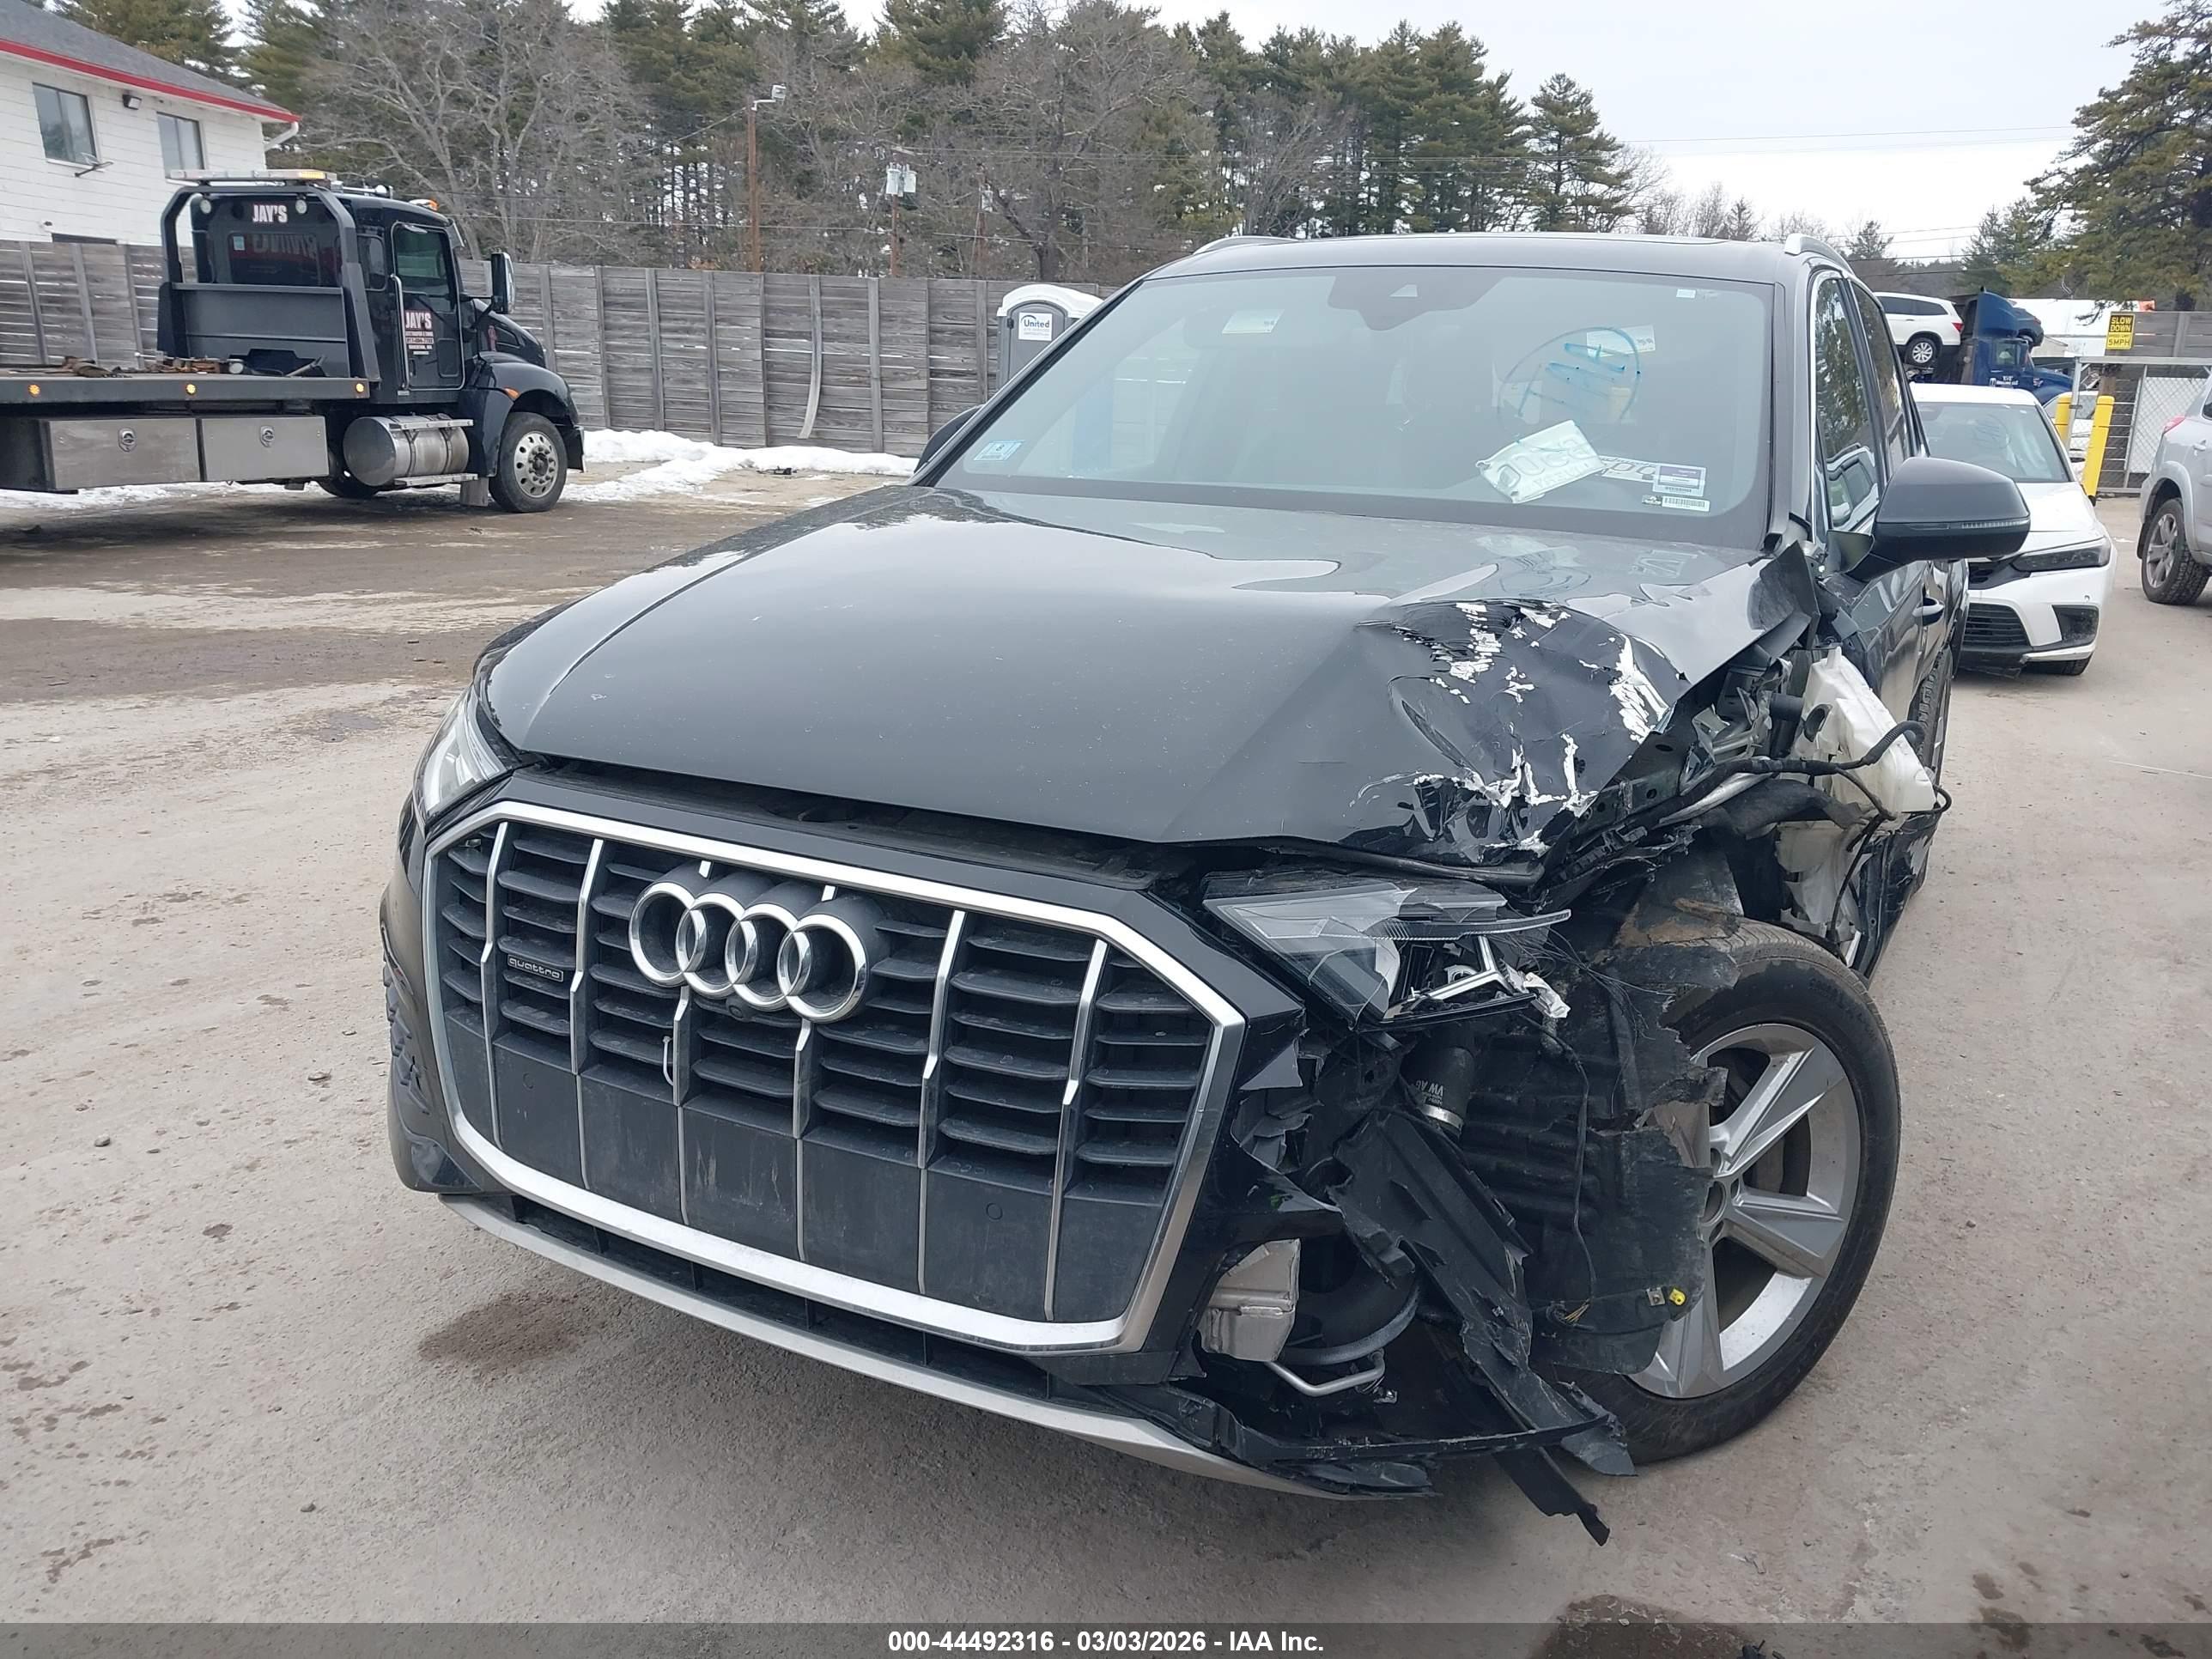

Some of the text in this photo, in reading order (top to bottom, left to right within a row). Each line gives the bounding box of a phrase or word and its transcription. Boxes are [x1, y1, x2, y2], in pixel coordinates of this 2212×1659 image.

[252, 204, 288, 222] JAY'S
[405, 312, 432, 330] JAY'S
[1024, 319, 1049, 328] United
[2111, 316, 2132, 325] SLOW
[509, 957, 560, 978] quattro
